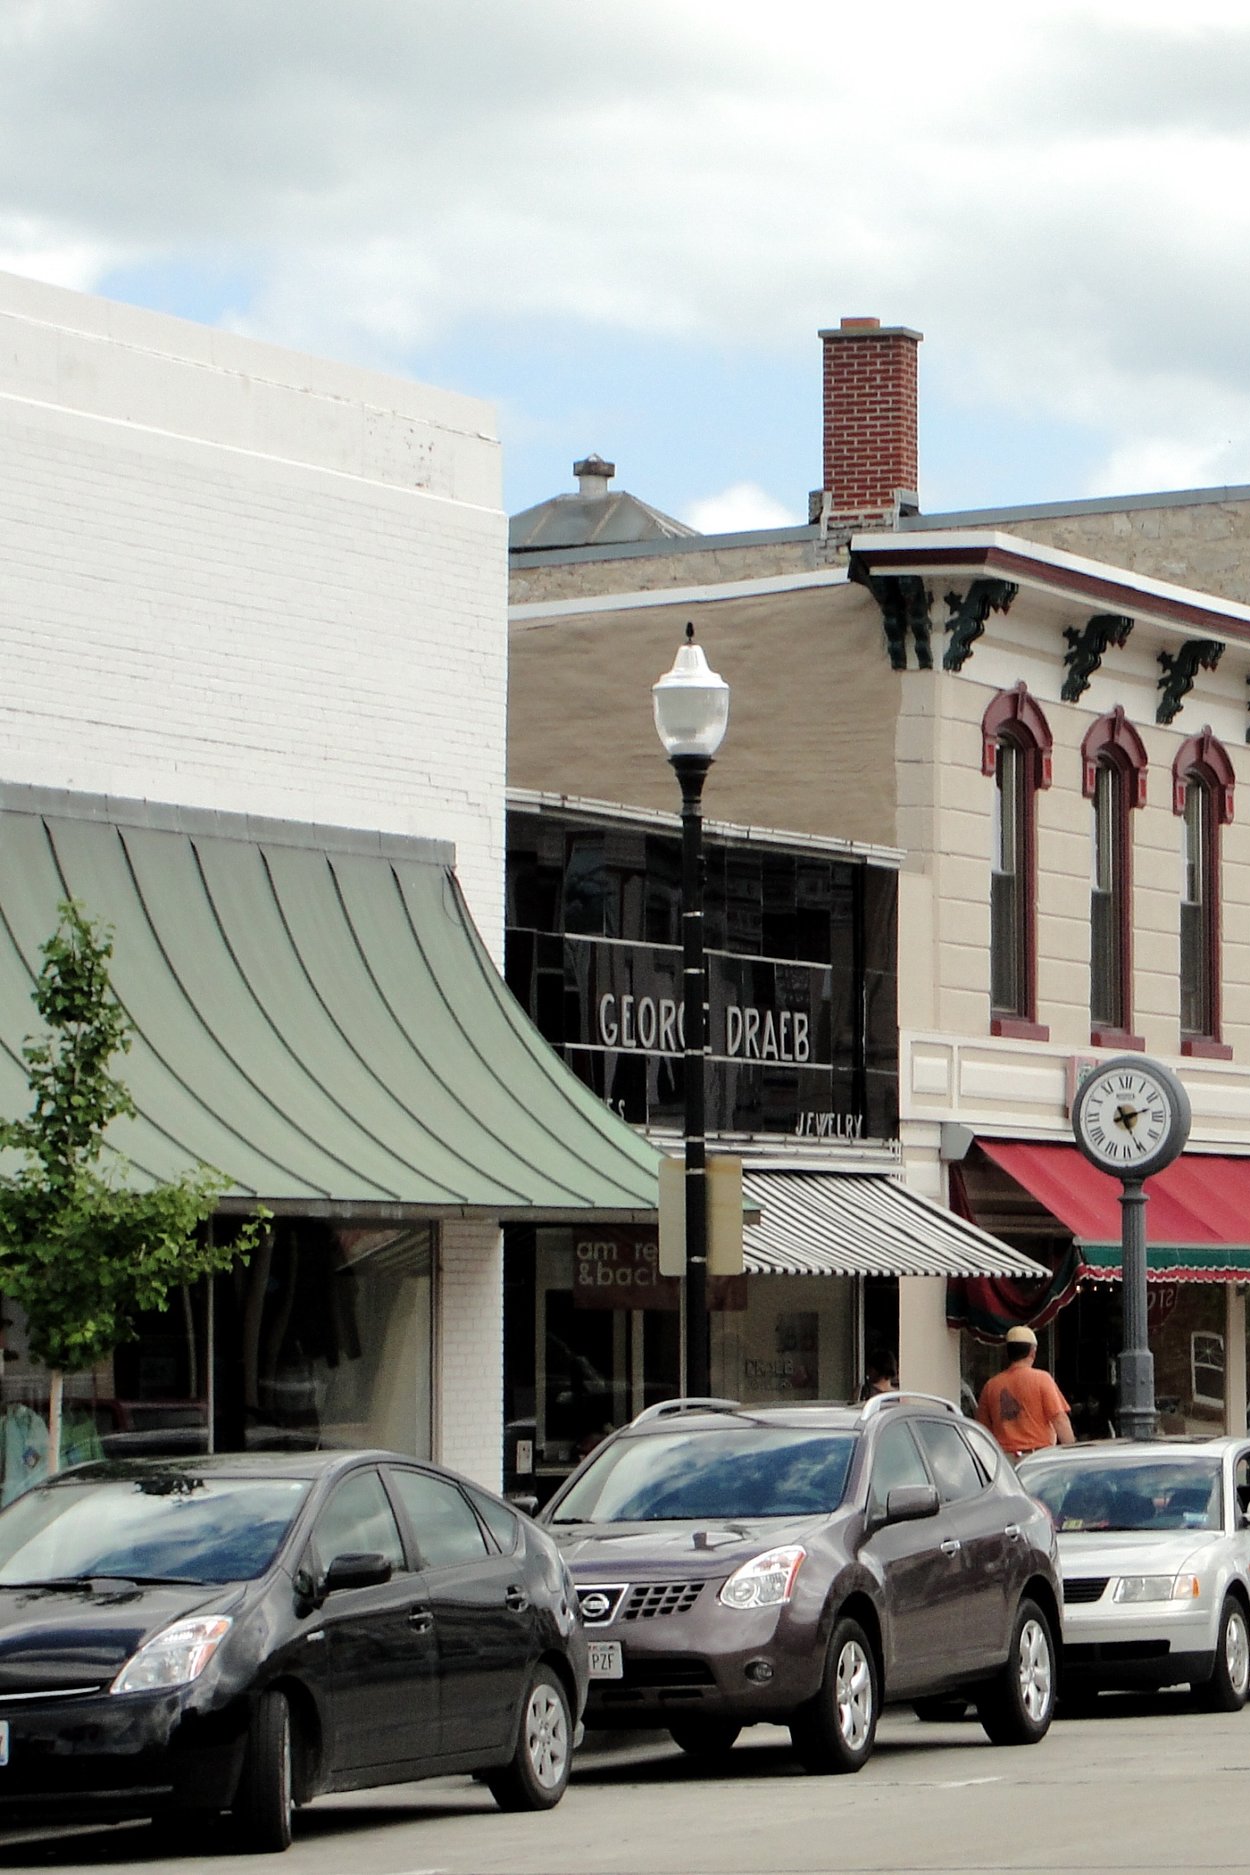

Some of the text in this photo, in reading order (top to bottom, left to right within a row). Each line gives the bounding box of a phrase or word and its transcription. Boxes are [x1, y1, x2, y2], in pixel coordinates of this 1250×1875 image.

[726, 1005, 810, 1062] DRAEB
[795, 1111, 863, 1138] JEWELRY
[592, 1653, 614, 1670] PZF
